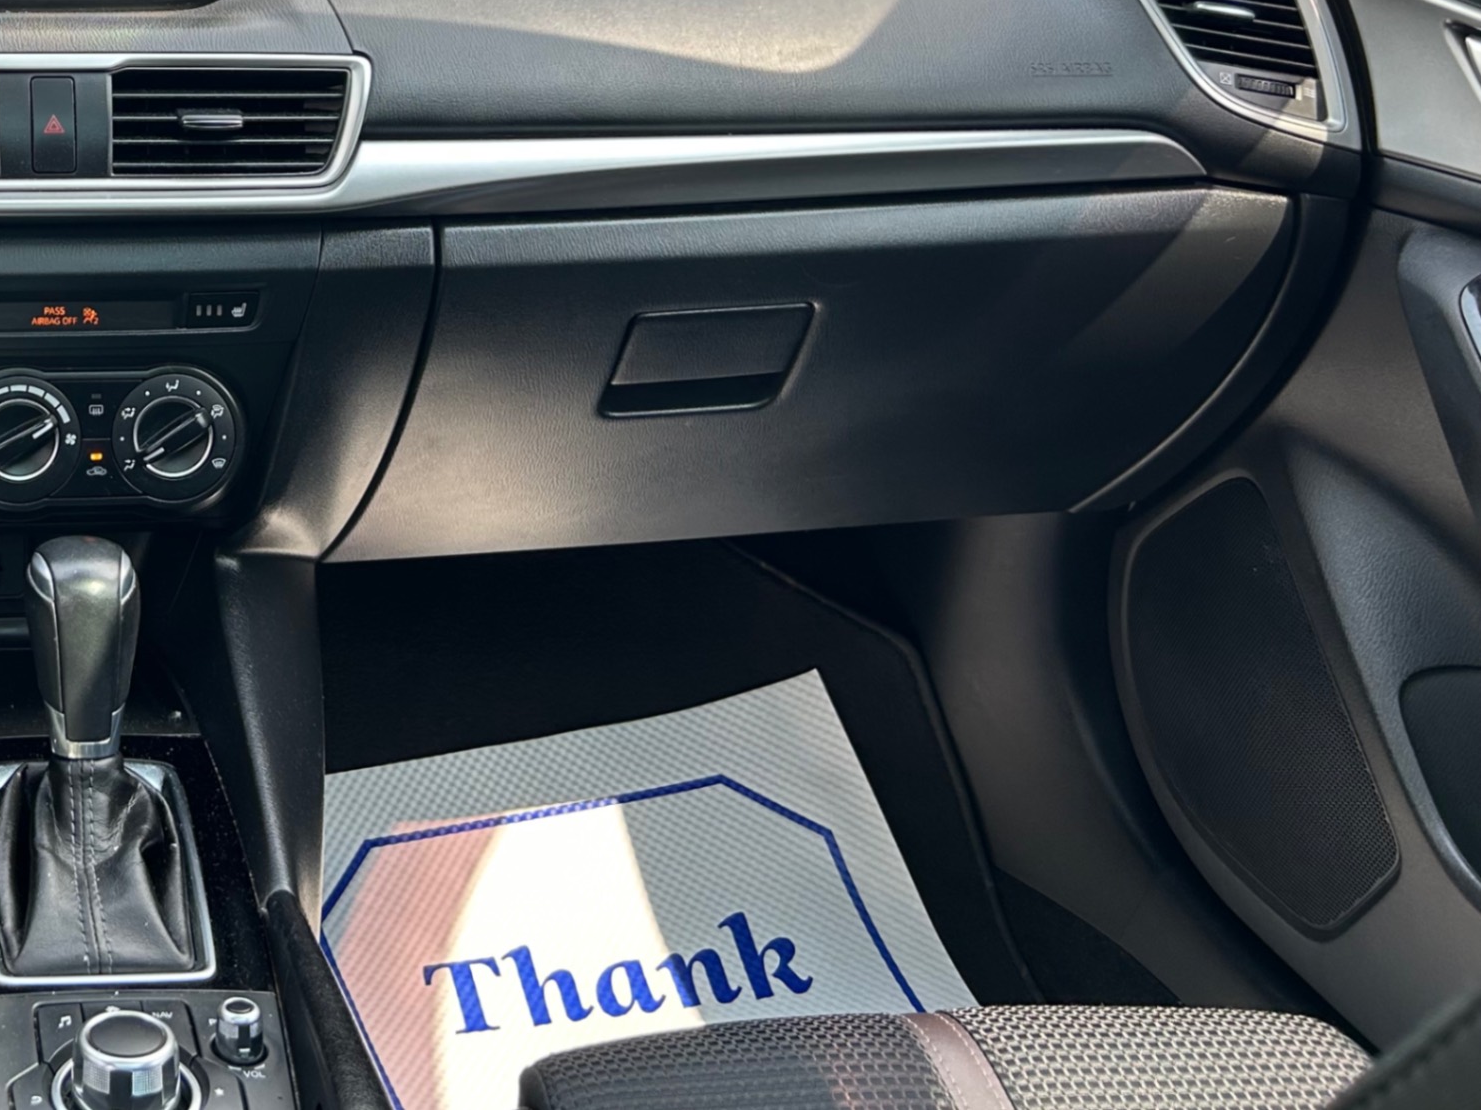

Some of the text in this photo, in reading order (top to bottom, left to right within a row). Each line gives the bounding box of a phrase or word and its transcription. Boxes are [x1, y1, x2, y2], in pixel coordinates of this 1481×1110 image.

[43, 306, 66, 316] PASS
[31, 316, 79, 326] AIRBAG OFF
[422, 911, 814, 1035] Thank
[242, 1070, 267, 1079] VOL
